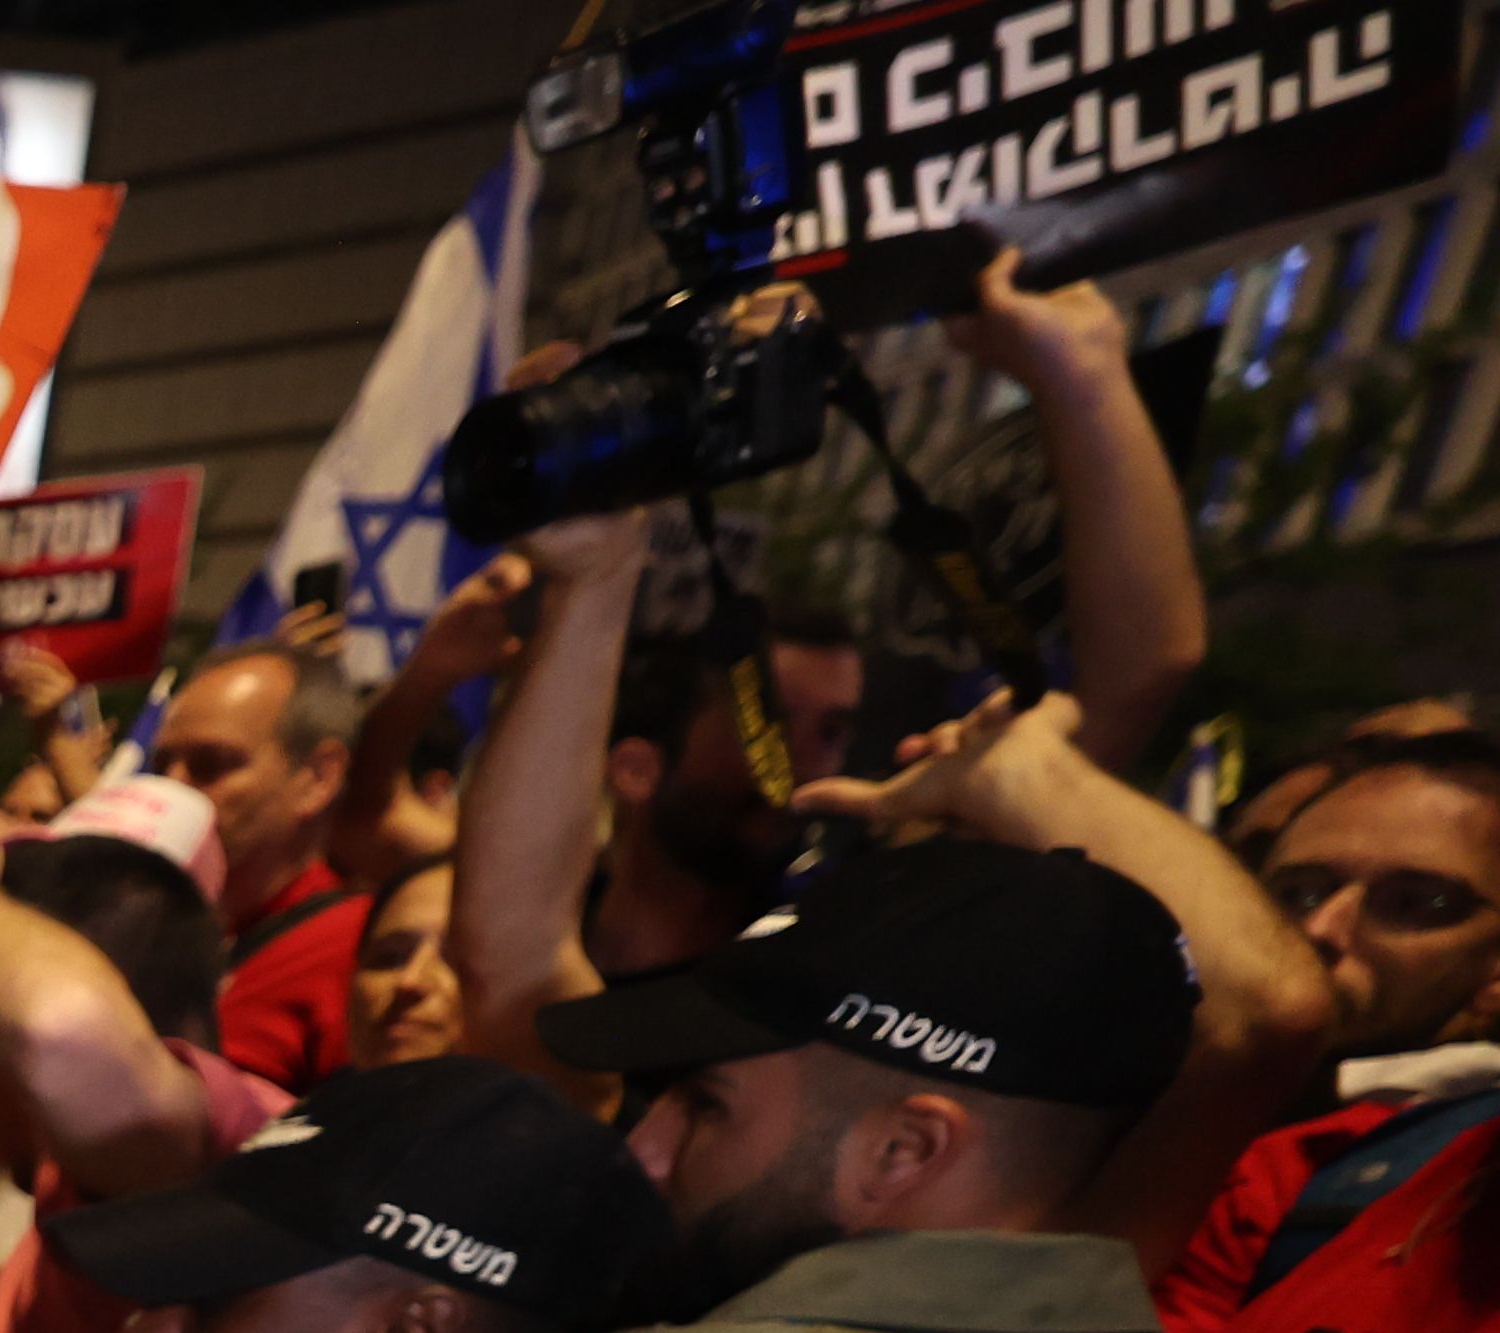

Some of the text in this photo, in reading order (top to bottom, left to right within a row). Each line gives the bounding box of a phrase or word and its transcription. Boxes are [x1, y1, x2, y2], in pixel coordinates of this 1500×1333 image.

[864, 9, 1393, 243] דמוקרטיה
[822, 991, 999, 1077] משטרה
[363, 1200, 518, 1288] משטרה
